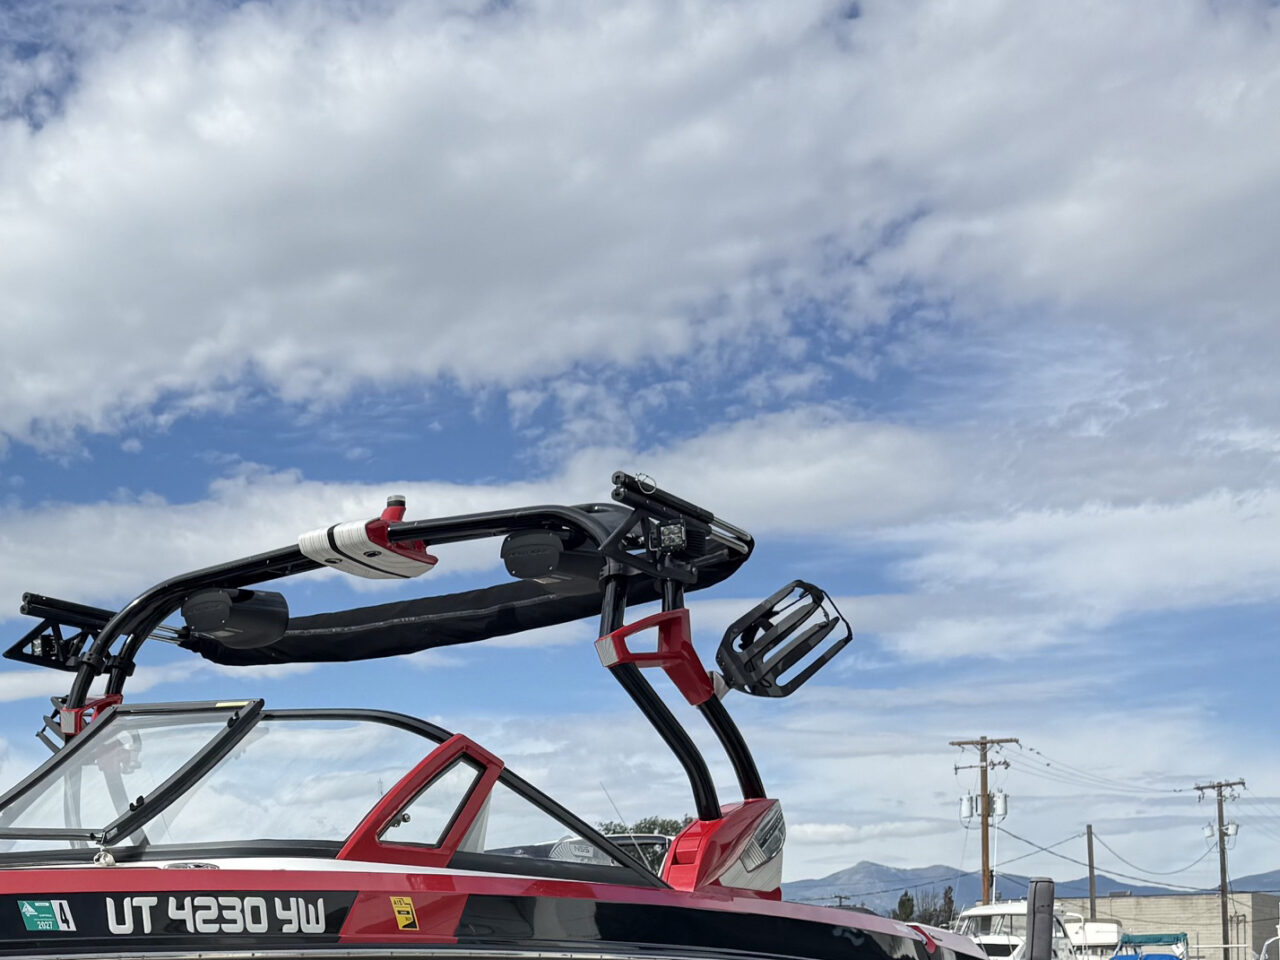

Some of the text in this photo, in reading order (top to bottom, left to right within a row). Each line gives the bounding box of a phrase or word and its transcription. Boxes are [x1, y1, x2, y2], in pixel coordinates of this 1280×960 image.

[37, 921, 53, 930] 2027
[59, 902, 70, 929] 4
[105, 896, 325, 935] UT 4230 YW
